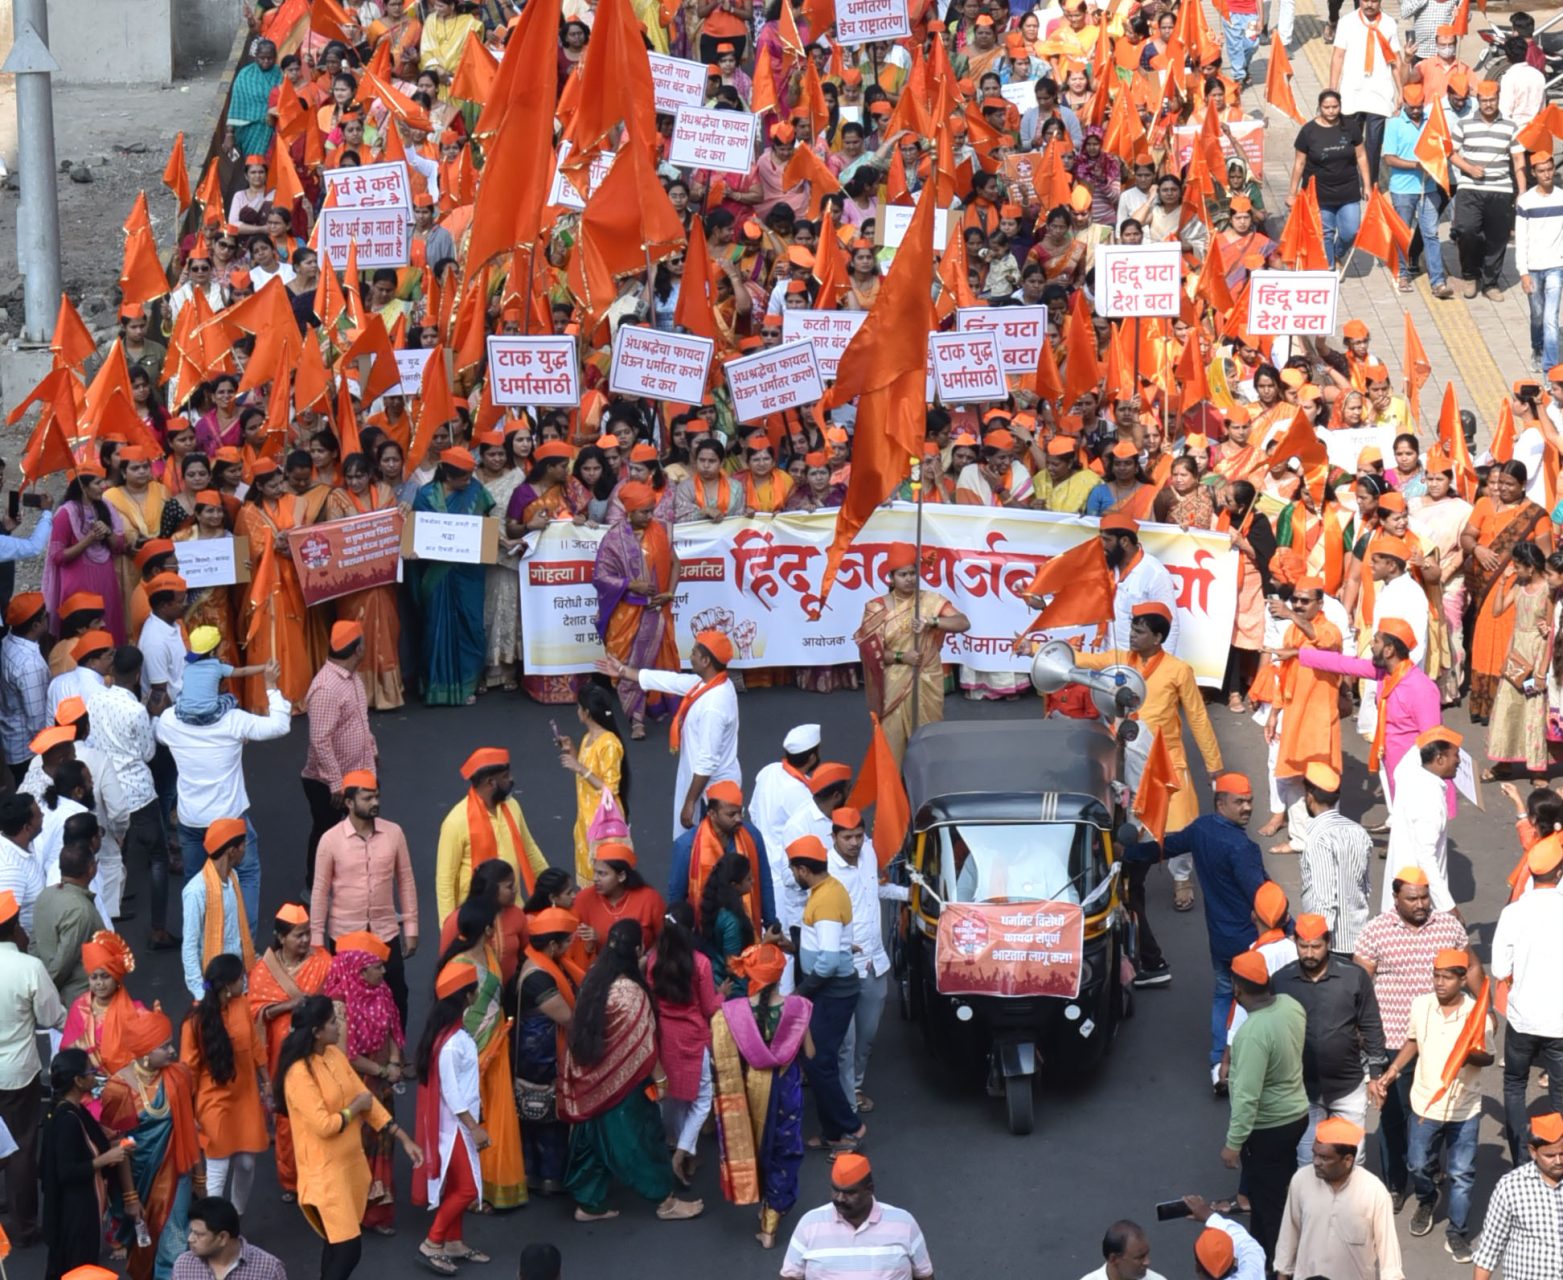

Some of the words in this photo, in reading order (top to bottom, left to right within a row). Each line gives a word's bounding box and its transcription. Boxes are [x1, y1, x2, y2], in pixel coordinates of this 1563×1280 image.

[839, 19, 856, 35] हेच
[675, 68, 690, 79] गाय
[672, 80, 685, 92] बंद
[686, 83, 702, 96] करो
[722, 119, 750, 132] फायदा
[676, 127, 697, 141] घेऊन
[727, 135, 749, 150] करणे
[694, 146, 707, 159] बंद
[709, 150, 726, 162] करा
[353, 176, 366, 193] से
[370, 171, 400, 191] कहो
[329, 219, 344, 238] देश
[346, 217, 360, 236] धर्म
[361, 221, 374, 236] का
[376, 220, 395, 236] नाता
[331, 244, 347, 259] गाय
[356, 239, 372, 258] मारी
[374, 242, 393, 258] माता
[1111, 257, 1142, 288] हिंदू
[1145, 265, 1174, 282] घटा
[1113, 291, 1138, 312] देश
[1144, 294, 1173, 311] बटा
[1258, 282, 1292, 309] हिंदू
[1297, 289, 1330, 305] घटा
[803, 316, 830, 331] कटती
[832, 320, 851, 332] गाय
[1257, 310, 1288, 330] देश
[1292, 315, 1327, 330] बटा
[1004, 321, 1039, 338] घटा
[625, 335, 671, 356] अंधश्रद्धेचा
[674, 346, 705, 362] फायदा
[831, 334, 846, 348] बंद
[497, 350, 532, 367] टाक
[537, 350, 568, 373] युद्ध
[937, 343, 965, 361] टाक
[968, 341, 993, 366] युद्ध
[1002, 348, 1037, 365] बटा
[621, 351, 644, 369] घेऊन
[679, 364, 704, 380] करणे
[733, 363, 777, 384] अंधश्रद्धेचा
[779, 352, 810, 370] फायदा
[498, 373, 571, 395] धर्मासाठी
[641, 374, 656, 389] बंद
[659, 379, 677, 393] करा
[734, 385, 758, 400] घेऊन
[791, 366, 815, 383] करणे
[941, 364, 998, 389] धर्मासाठी
[760, 395, 777, 409] बंद
[777, 391, 796, 405] करा
[531, 566, 575, 583] गोहत्या
[730, 529, 822, 618] हिंदू
[553, 595, 581, 609] विरोधी
[563, 614, 587, 627] देशात
[575, 633, 584, 643] या
[802, 636, 846, 647] आयोजक
[1035, 912, 1065, 927] विरोधी
[1035, 930, 1061, 948] संपूर्ण
[1028, 950, 1050, 967] लागू
